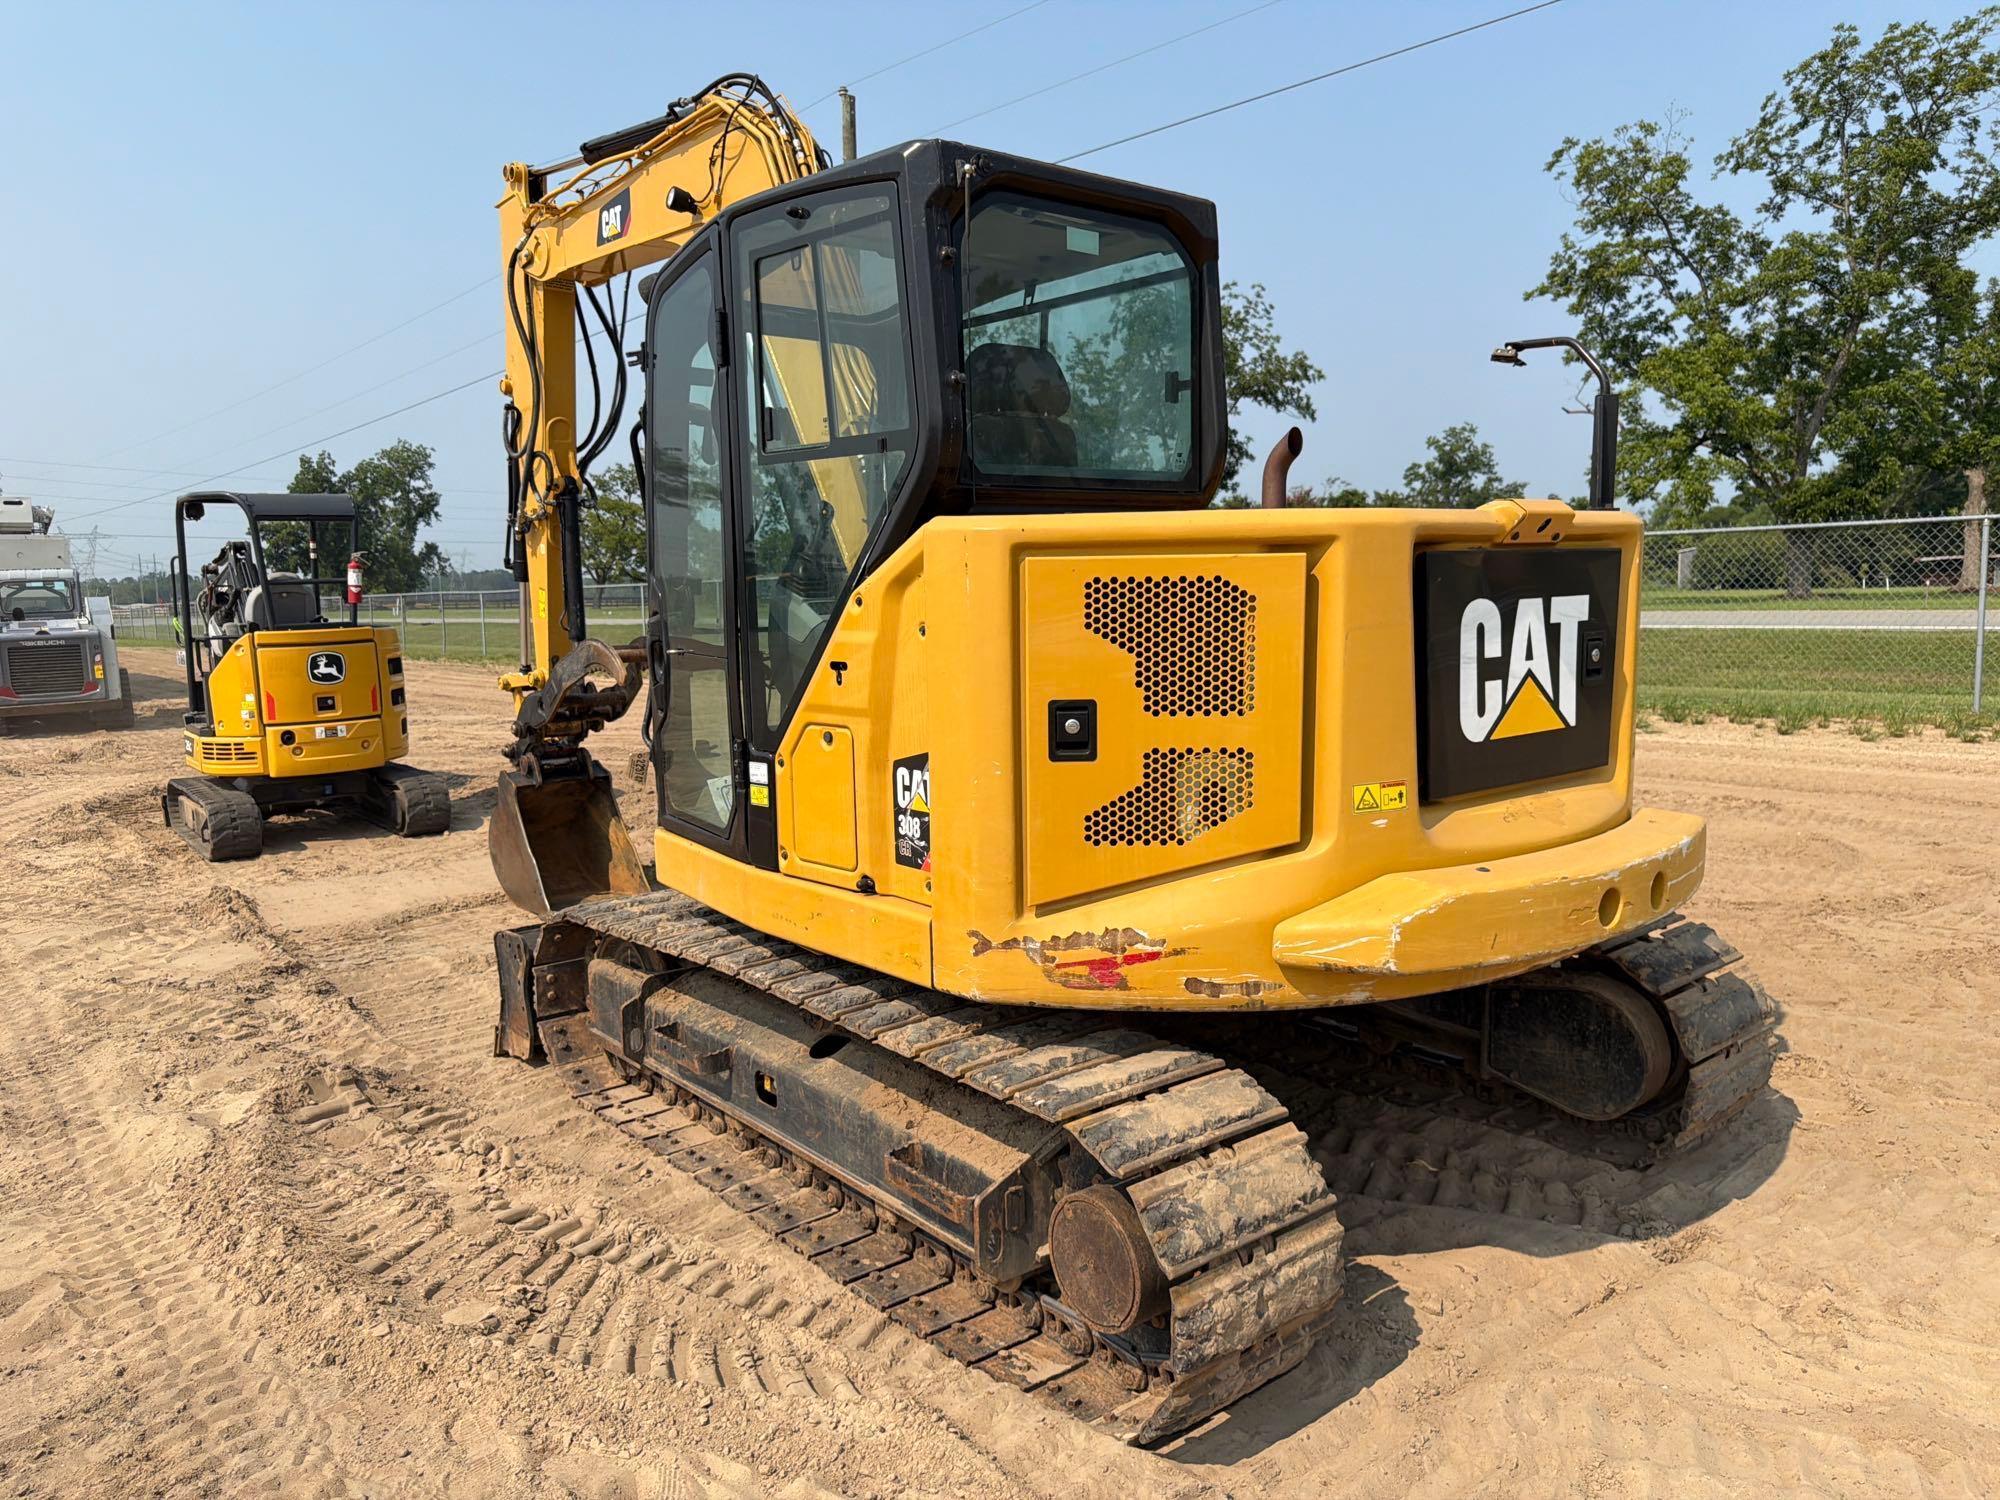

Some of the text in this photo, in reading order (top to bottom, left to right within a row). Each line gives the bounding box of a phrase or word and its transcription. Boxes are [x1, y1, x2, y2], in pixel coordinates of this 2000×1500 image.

[601, 205, 622, 239] CAT
[1459, 594, 1590, 743] CAT
[898, 814, 921, 839] 308
